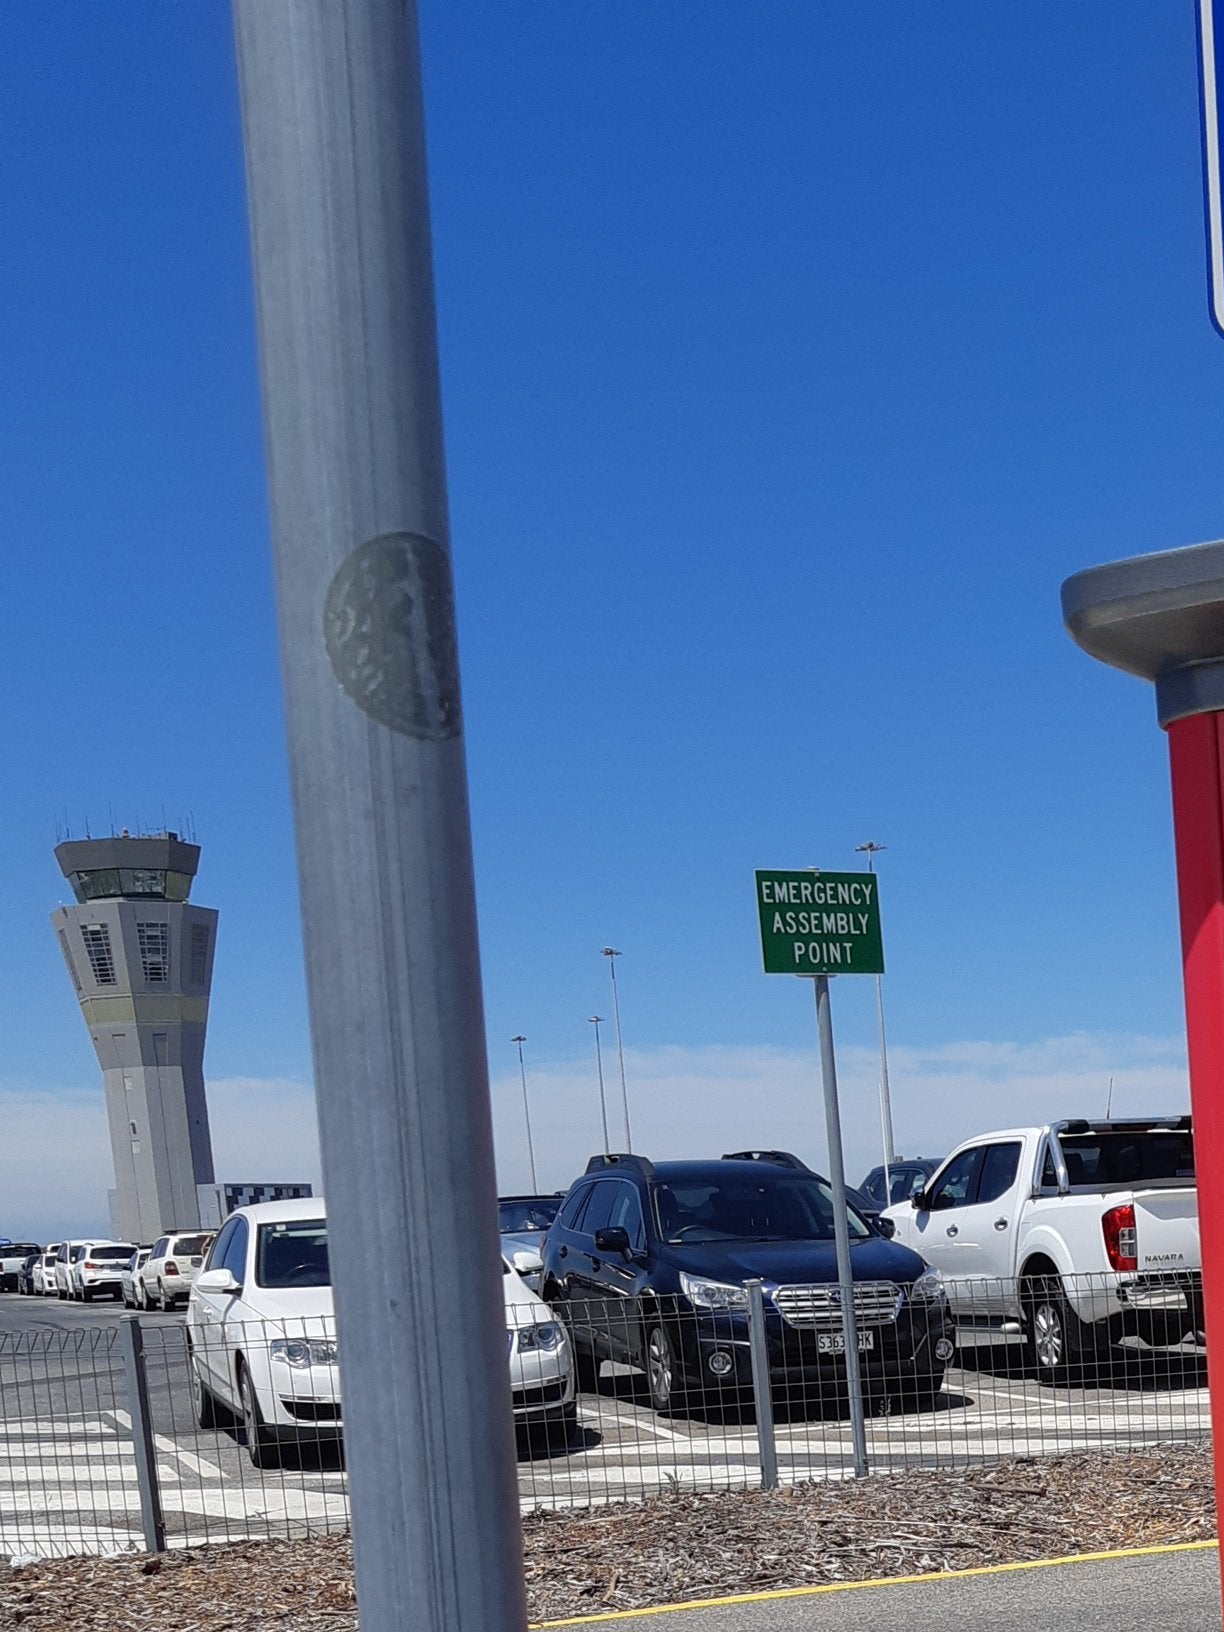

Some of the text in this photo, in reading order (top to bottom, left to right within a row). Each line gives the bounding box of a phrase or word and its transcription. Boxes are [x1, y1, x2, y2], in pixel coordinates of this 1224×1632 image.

[761, 881, 873, 906] EMERGENCY
[773, 911, 869, 935] ASSEMBLY
[793, 942, 853, 964] POINT
[1145, 1253, 1184, 1262] NAVARA
